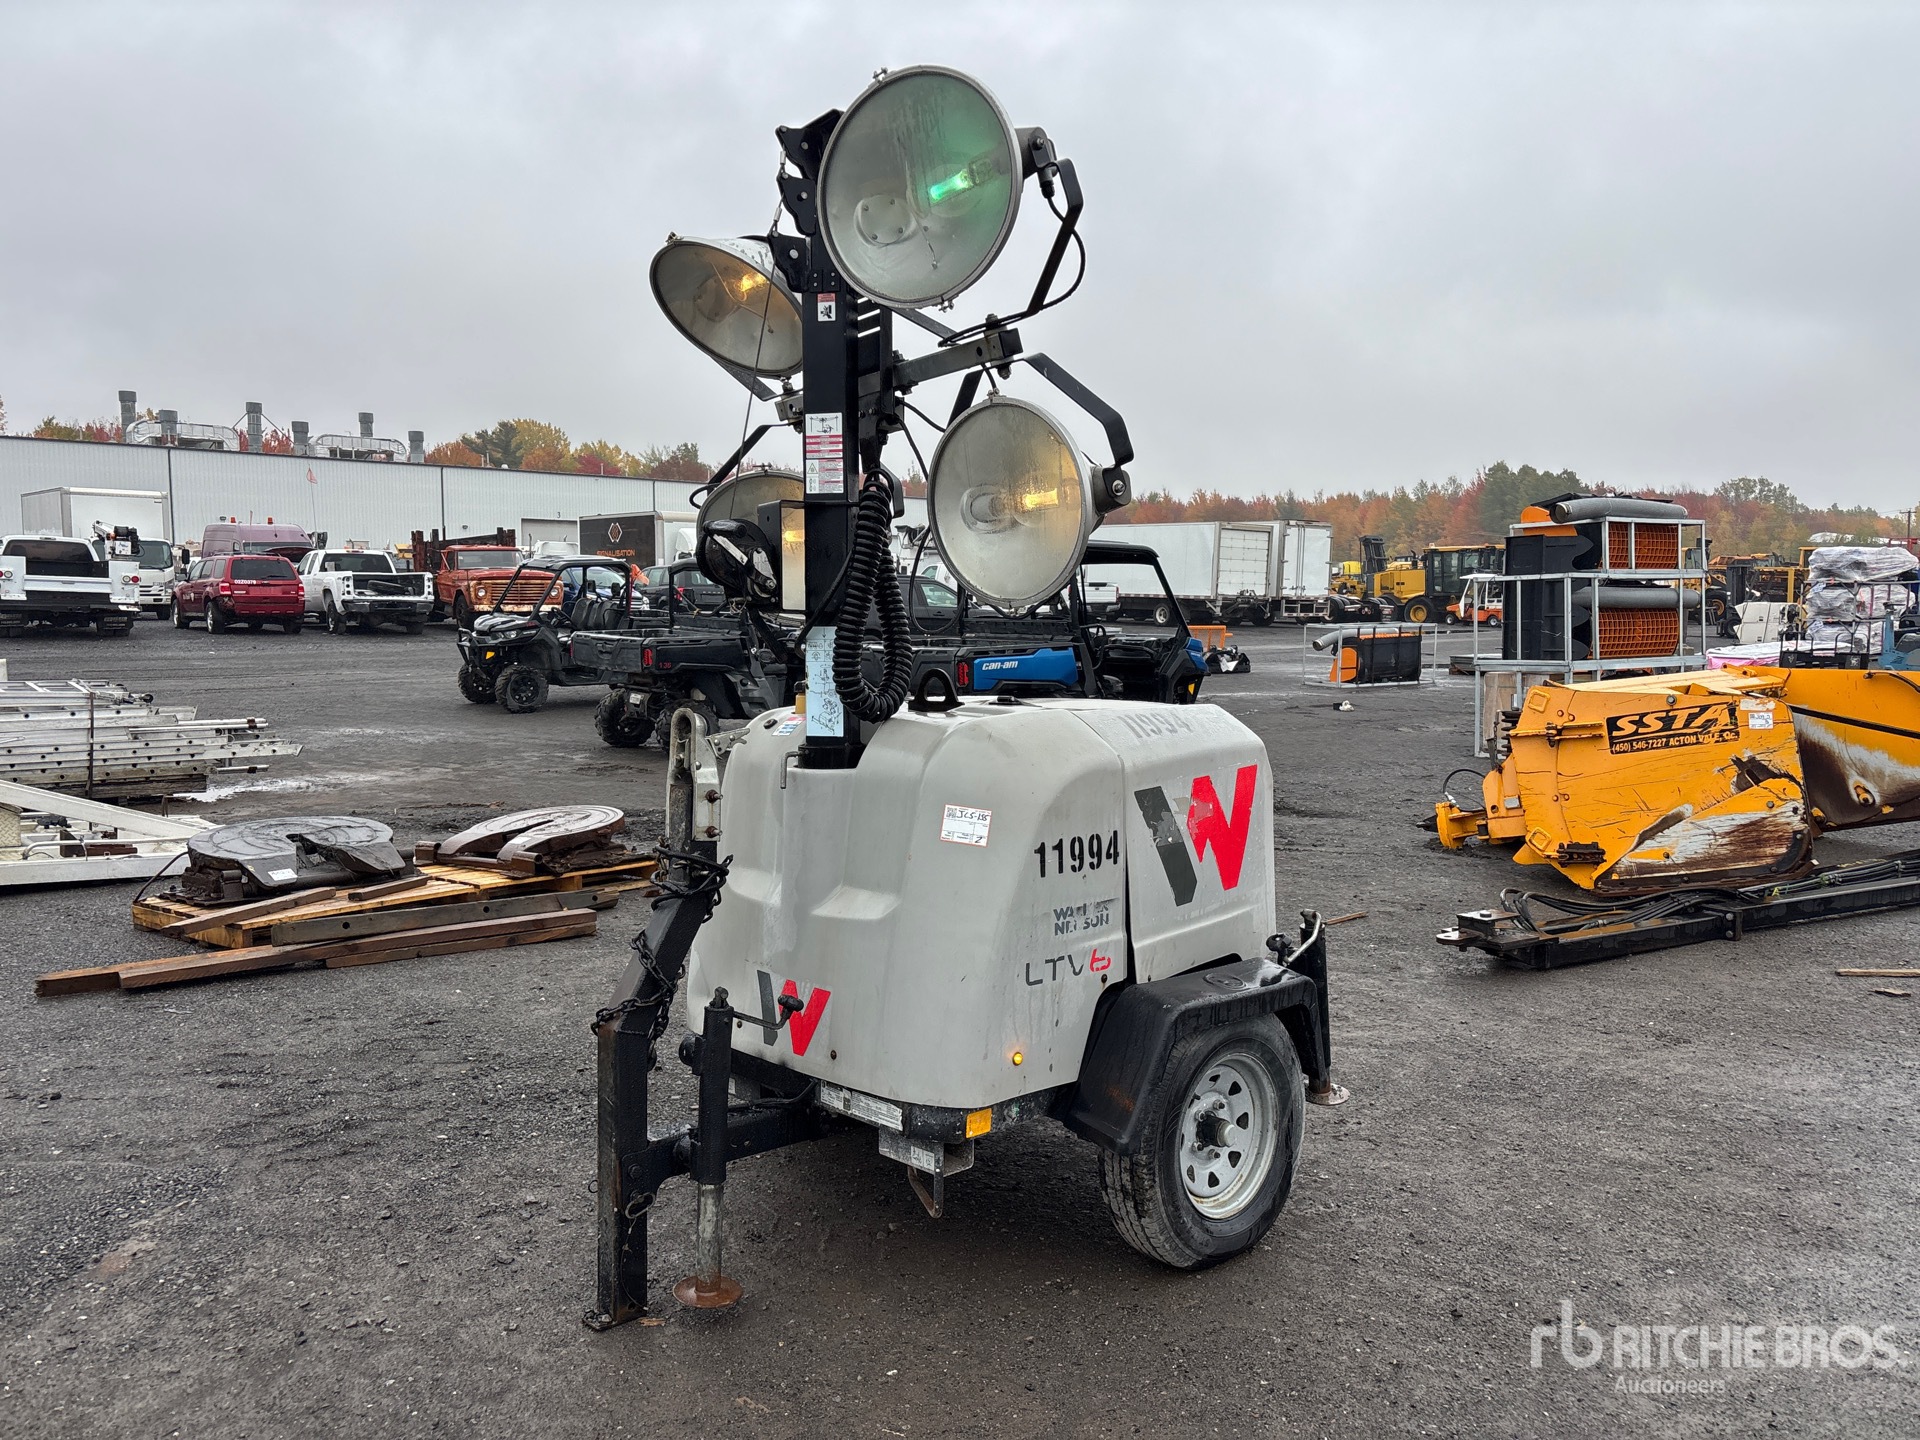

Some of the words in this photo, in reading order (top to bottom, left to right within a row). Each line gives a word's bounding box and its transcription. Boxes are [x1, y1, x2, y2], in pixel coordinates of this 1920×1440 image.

[556, 511, 561, 519] 3
[982, 660, 1019, 671] can-am
[1612, 703, 1739, 737] SSTA
[1612, 742, 1631, 754] (450)
[1633, 740, 1667, 750] 546-7227
[1669, 734, 1697, 747] ACTON
[1033, 829, 1120, 878] 11994
